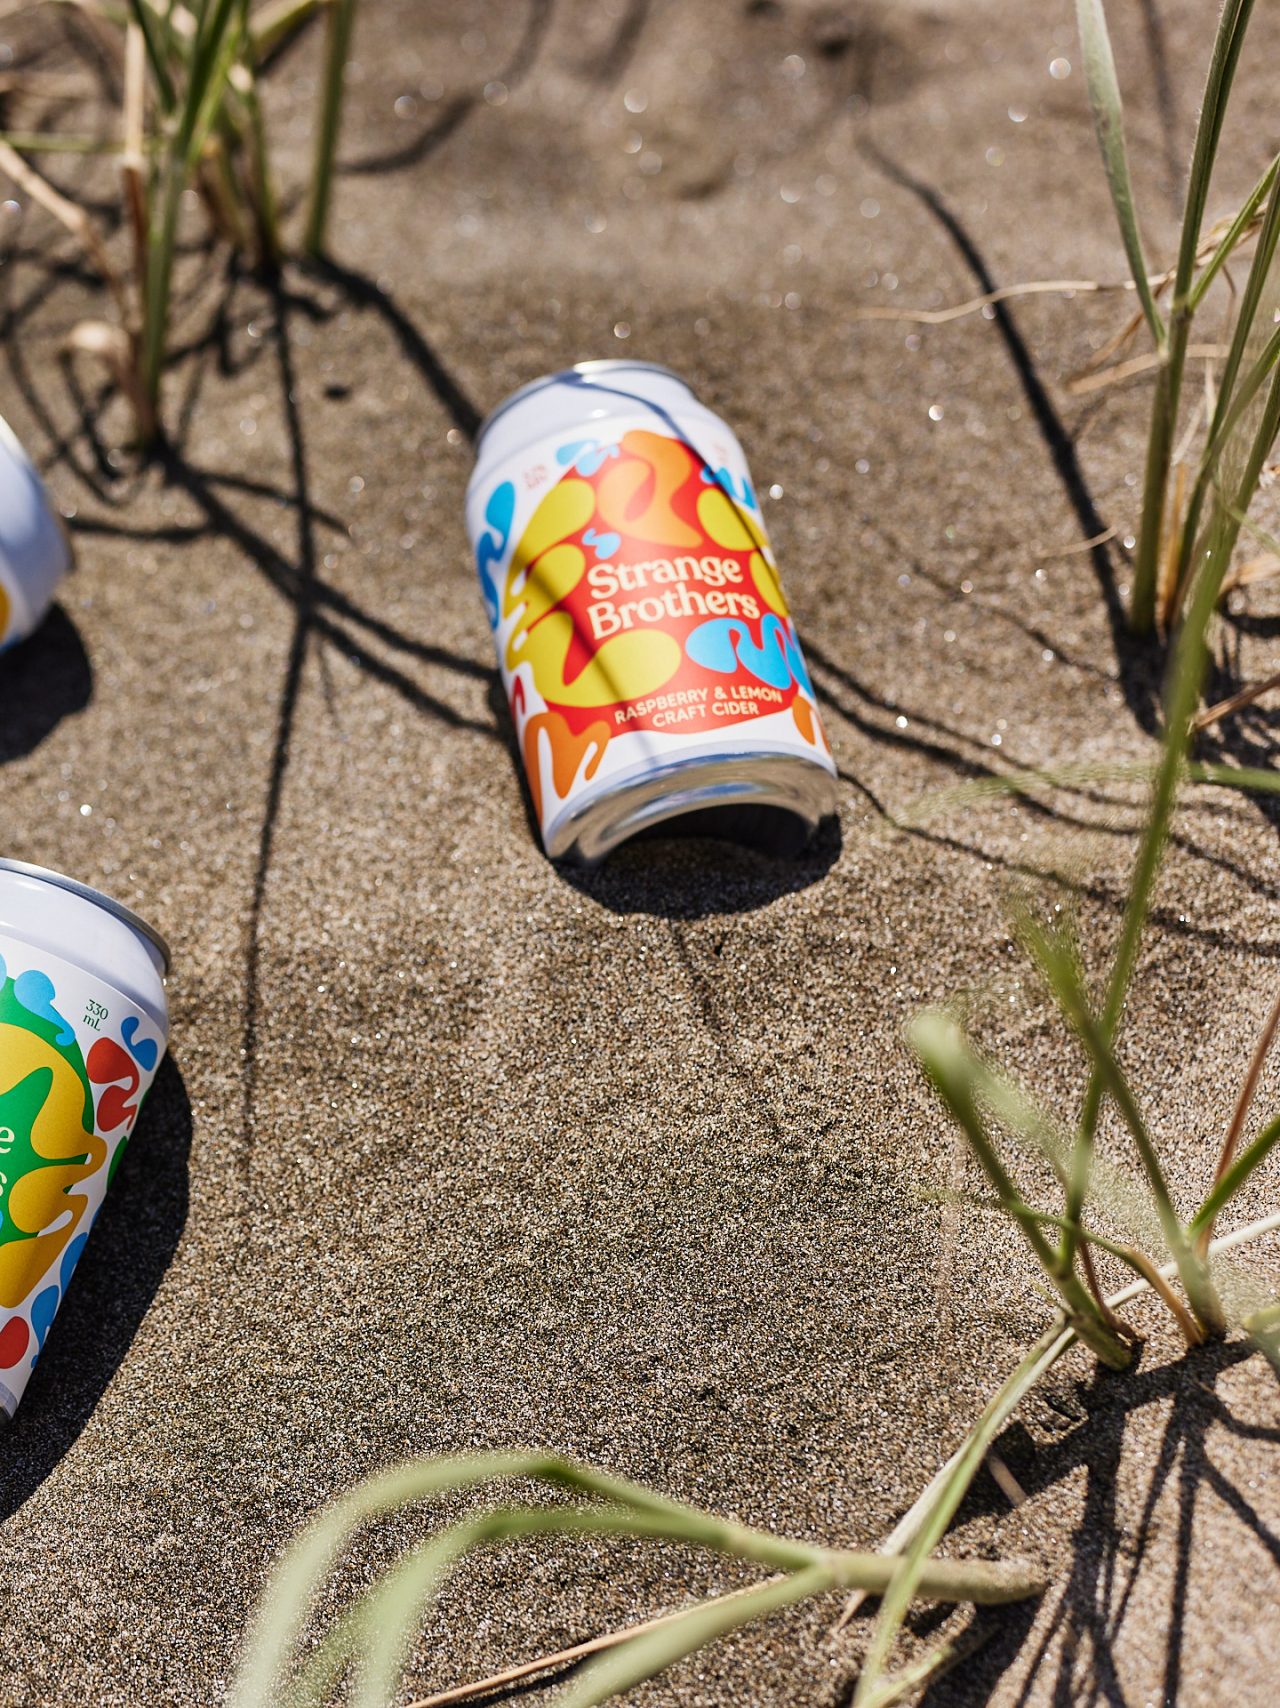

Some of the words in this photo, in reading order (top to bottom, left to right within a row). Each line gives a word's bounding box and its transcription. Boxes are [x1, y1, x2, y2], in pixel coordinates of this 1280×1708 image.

[587, 556, 743, 599] Strange
[587, 582, 760, 640] Brothers
[614, 688, 708, 724] RASPBERRY
[714, 686, 728, 700] &
[730, 685, 783, 704] LEMON
[652, 704, 707, 728] CRAFT
[711, 701, 759, 716] CIDER
[83, 1014, 101, 1032] mL
[85, 998, 109, 1020] 330
